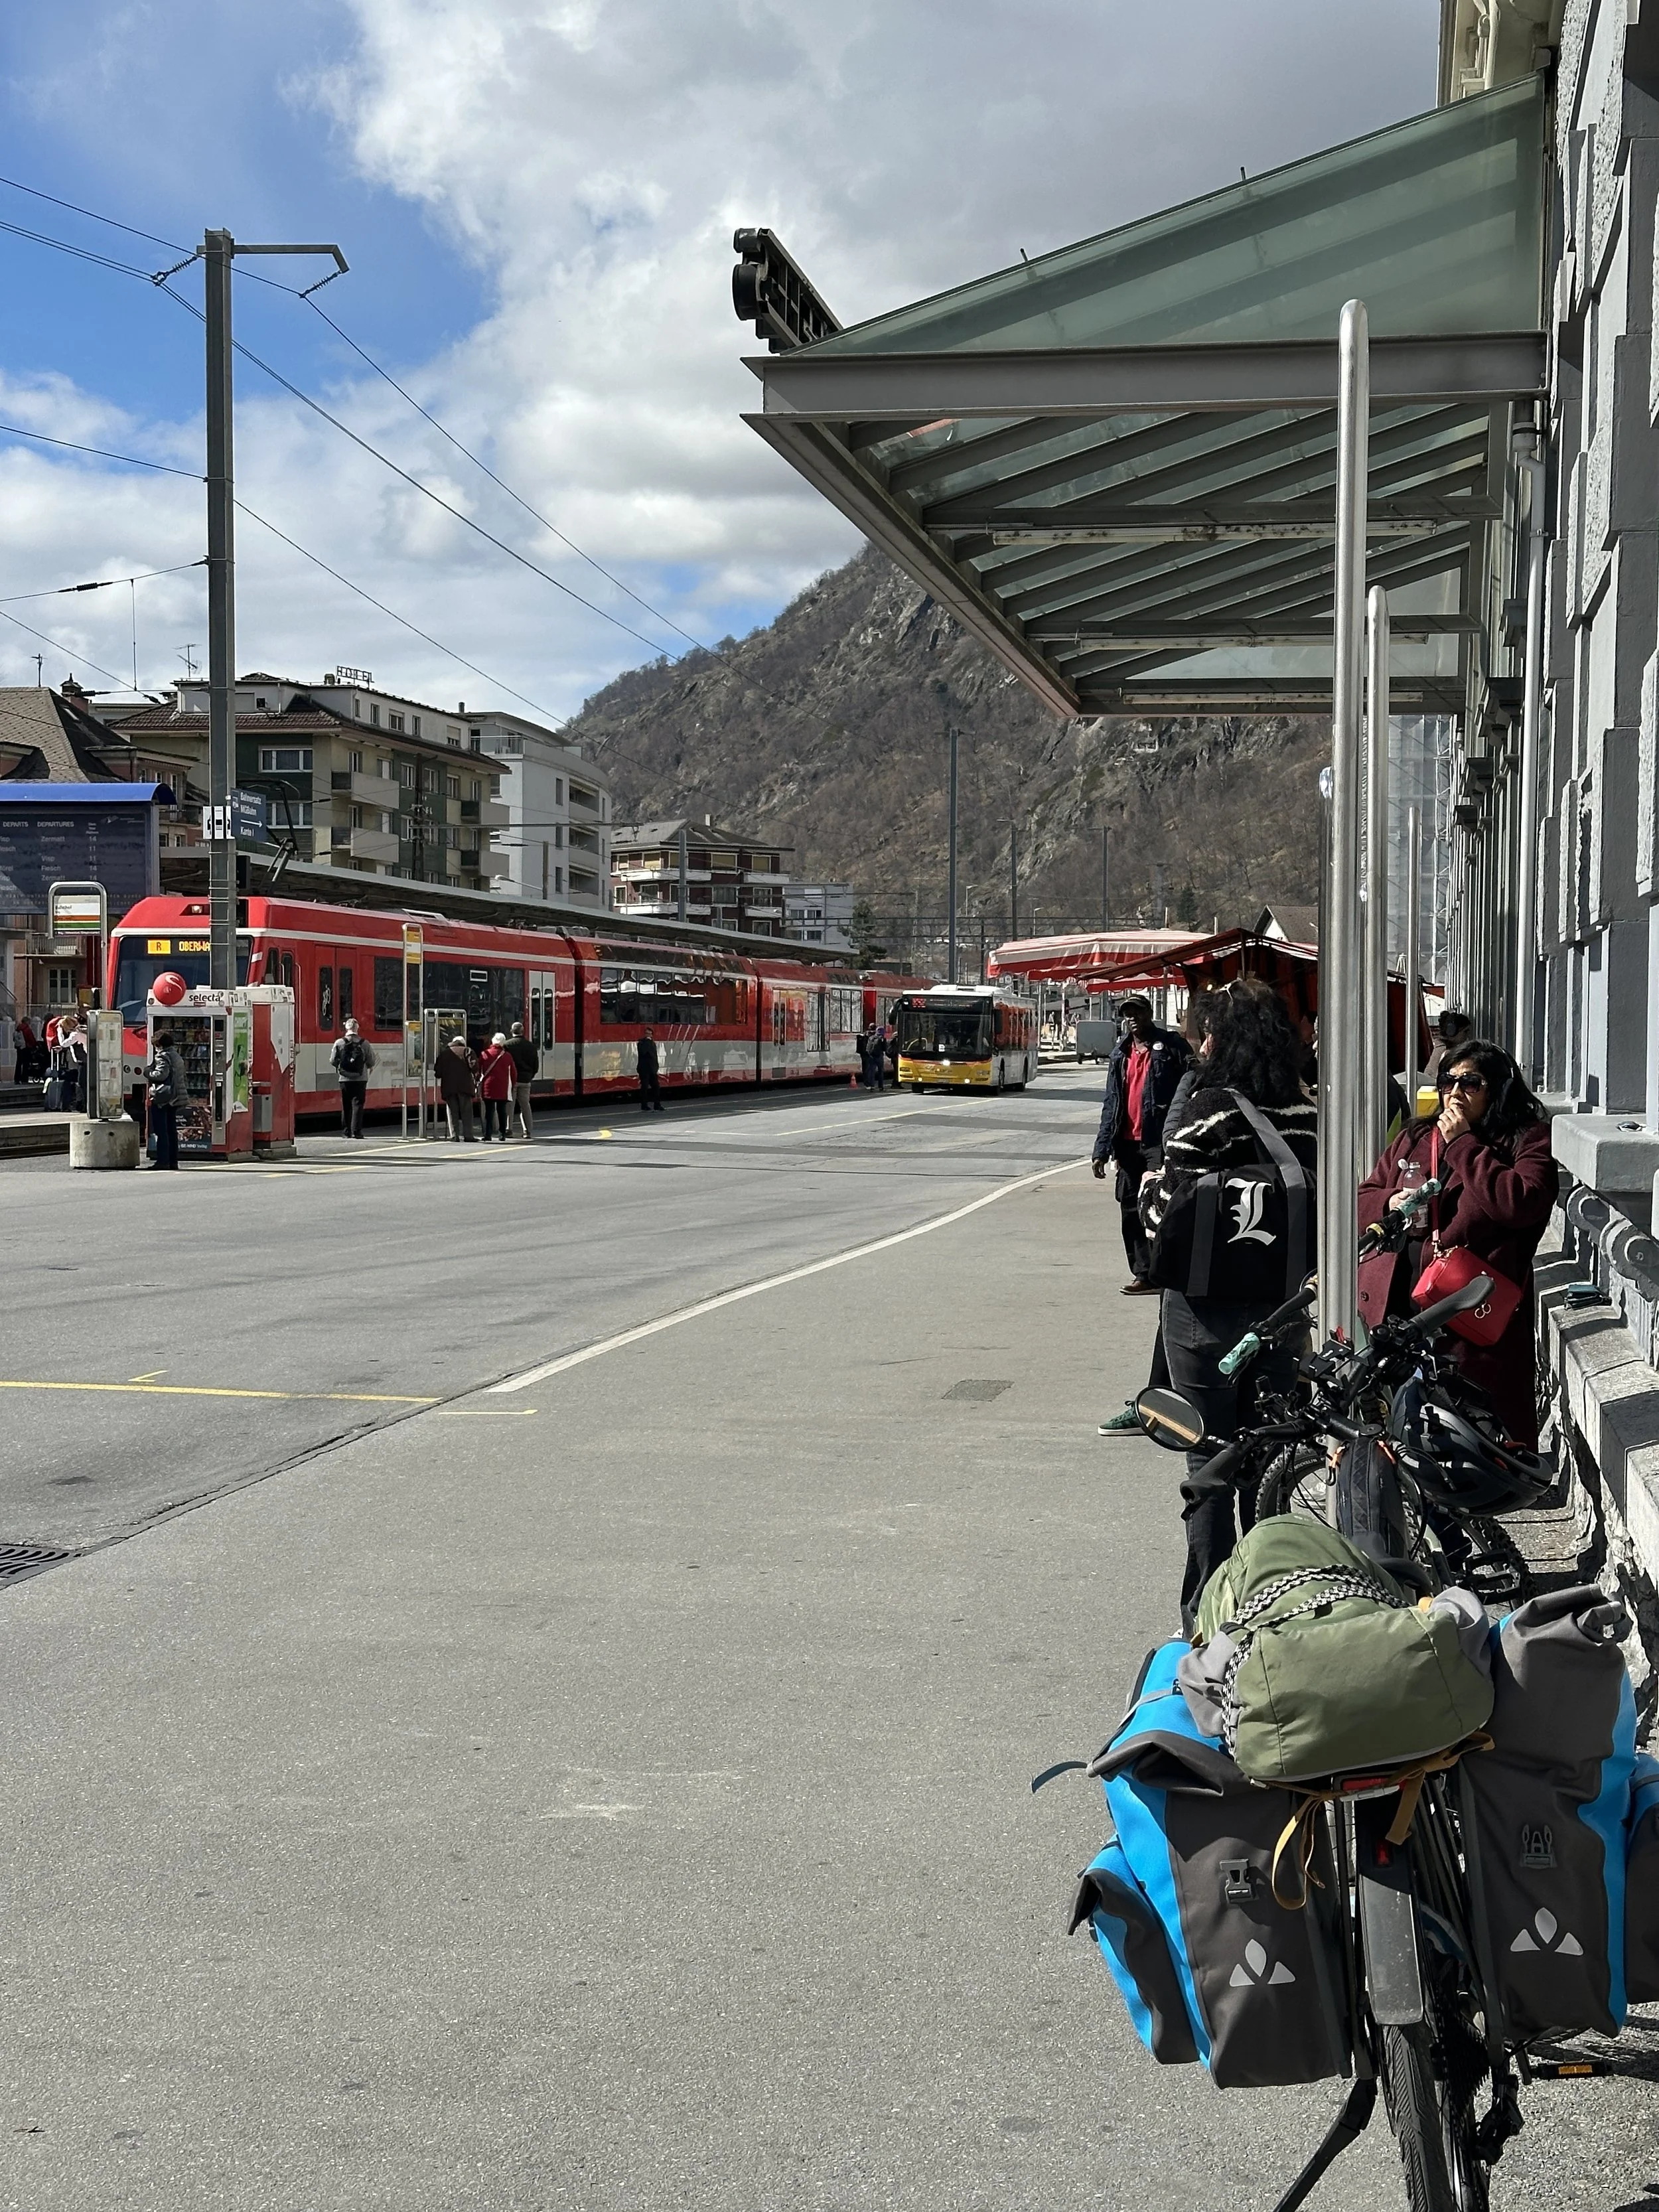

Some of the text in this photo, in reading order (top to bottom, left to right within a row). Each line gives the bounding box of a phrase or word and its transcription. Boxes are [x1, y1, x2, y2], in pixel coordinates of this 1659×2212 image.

[336, 666, 374, 683] HOTEL
[156, 942, 162, 951] R
[1225, 1178, 1276, 1246] L
